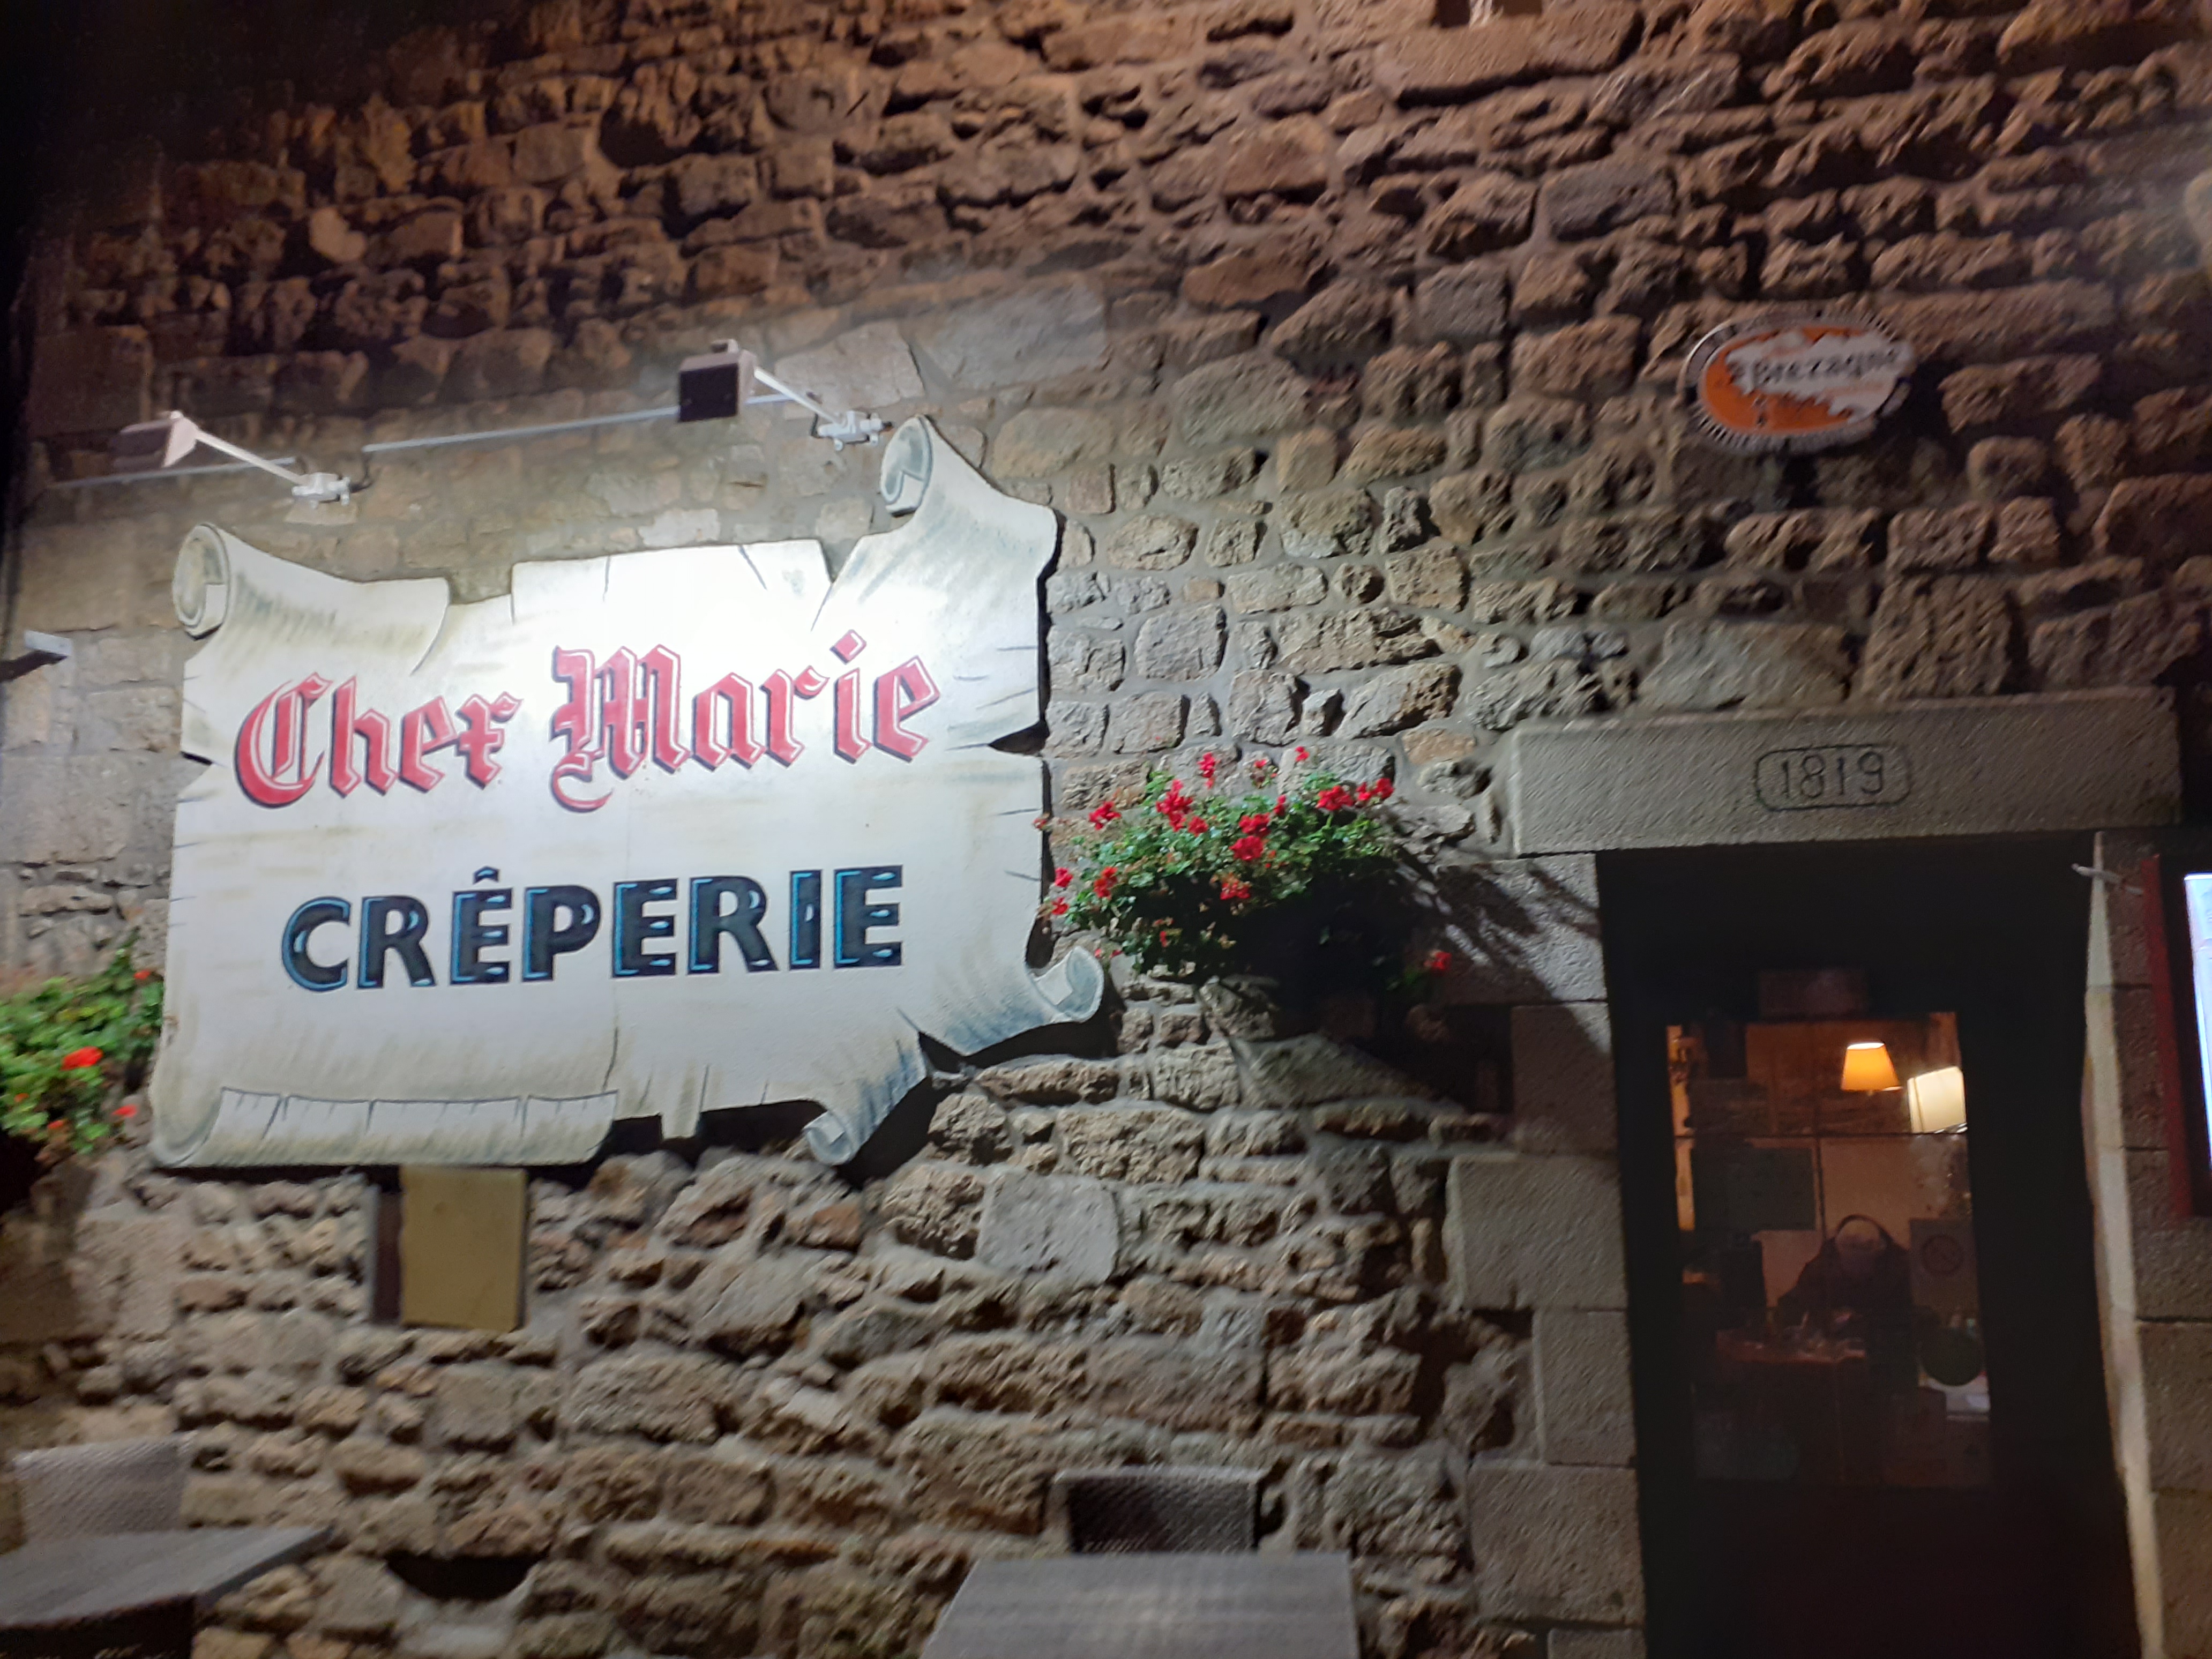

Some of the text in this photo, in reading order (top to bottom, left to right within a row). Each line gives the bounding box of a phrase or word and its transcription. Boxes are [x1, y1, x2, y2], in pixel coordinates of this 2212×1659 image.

[551, 630, 941, 813] Marie
[1781, 751, 1884, 799] 1819
[281, 865, 904, 993] CRÊPERIE
